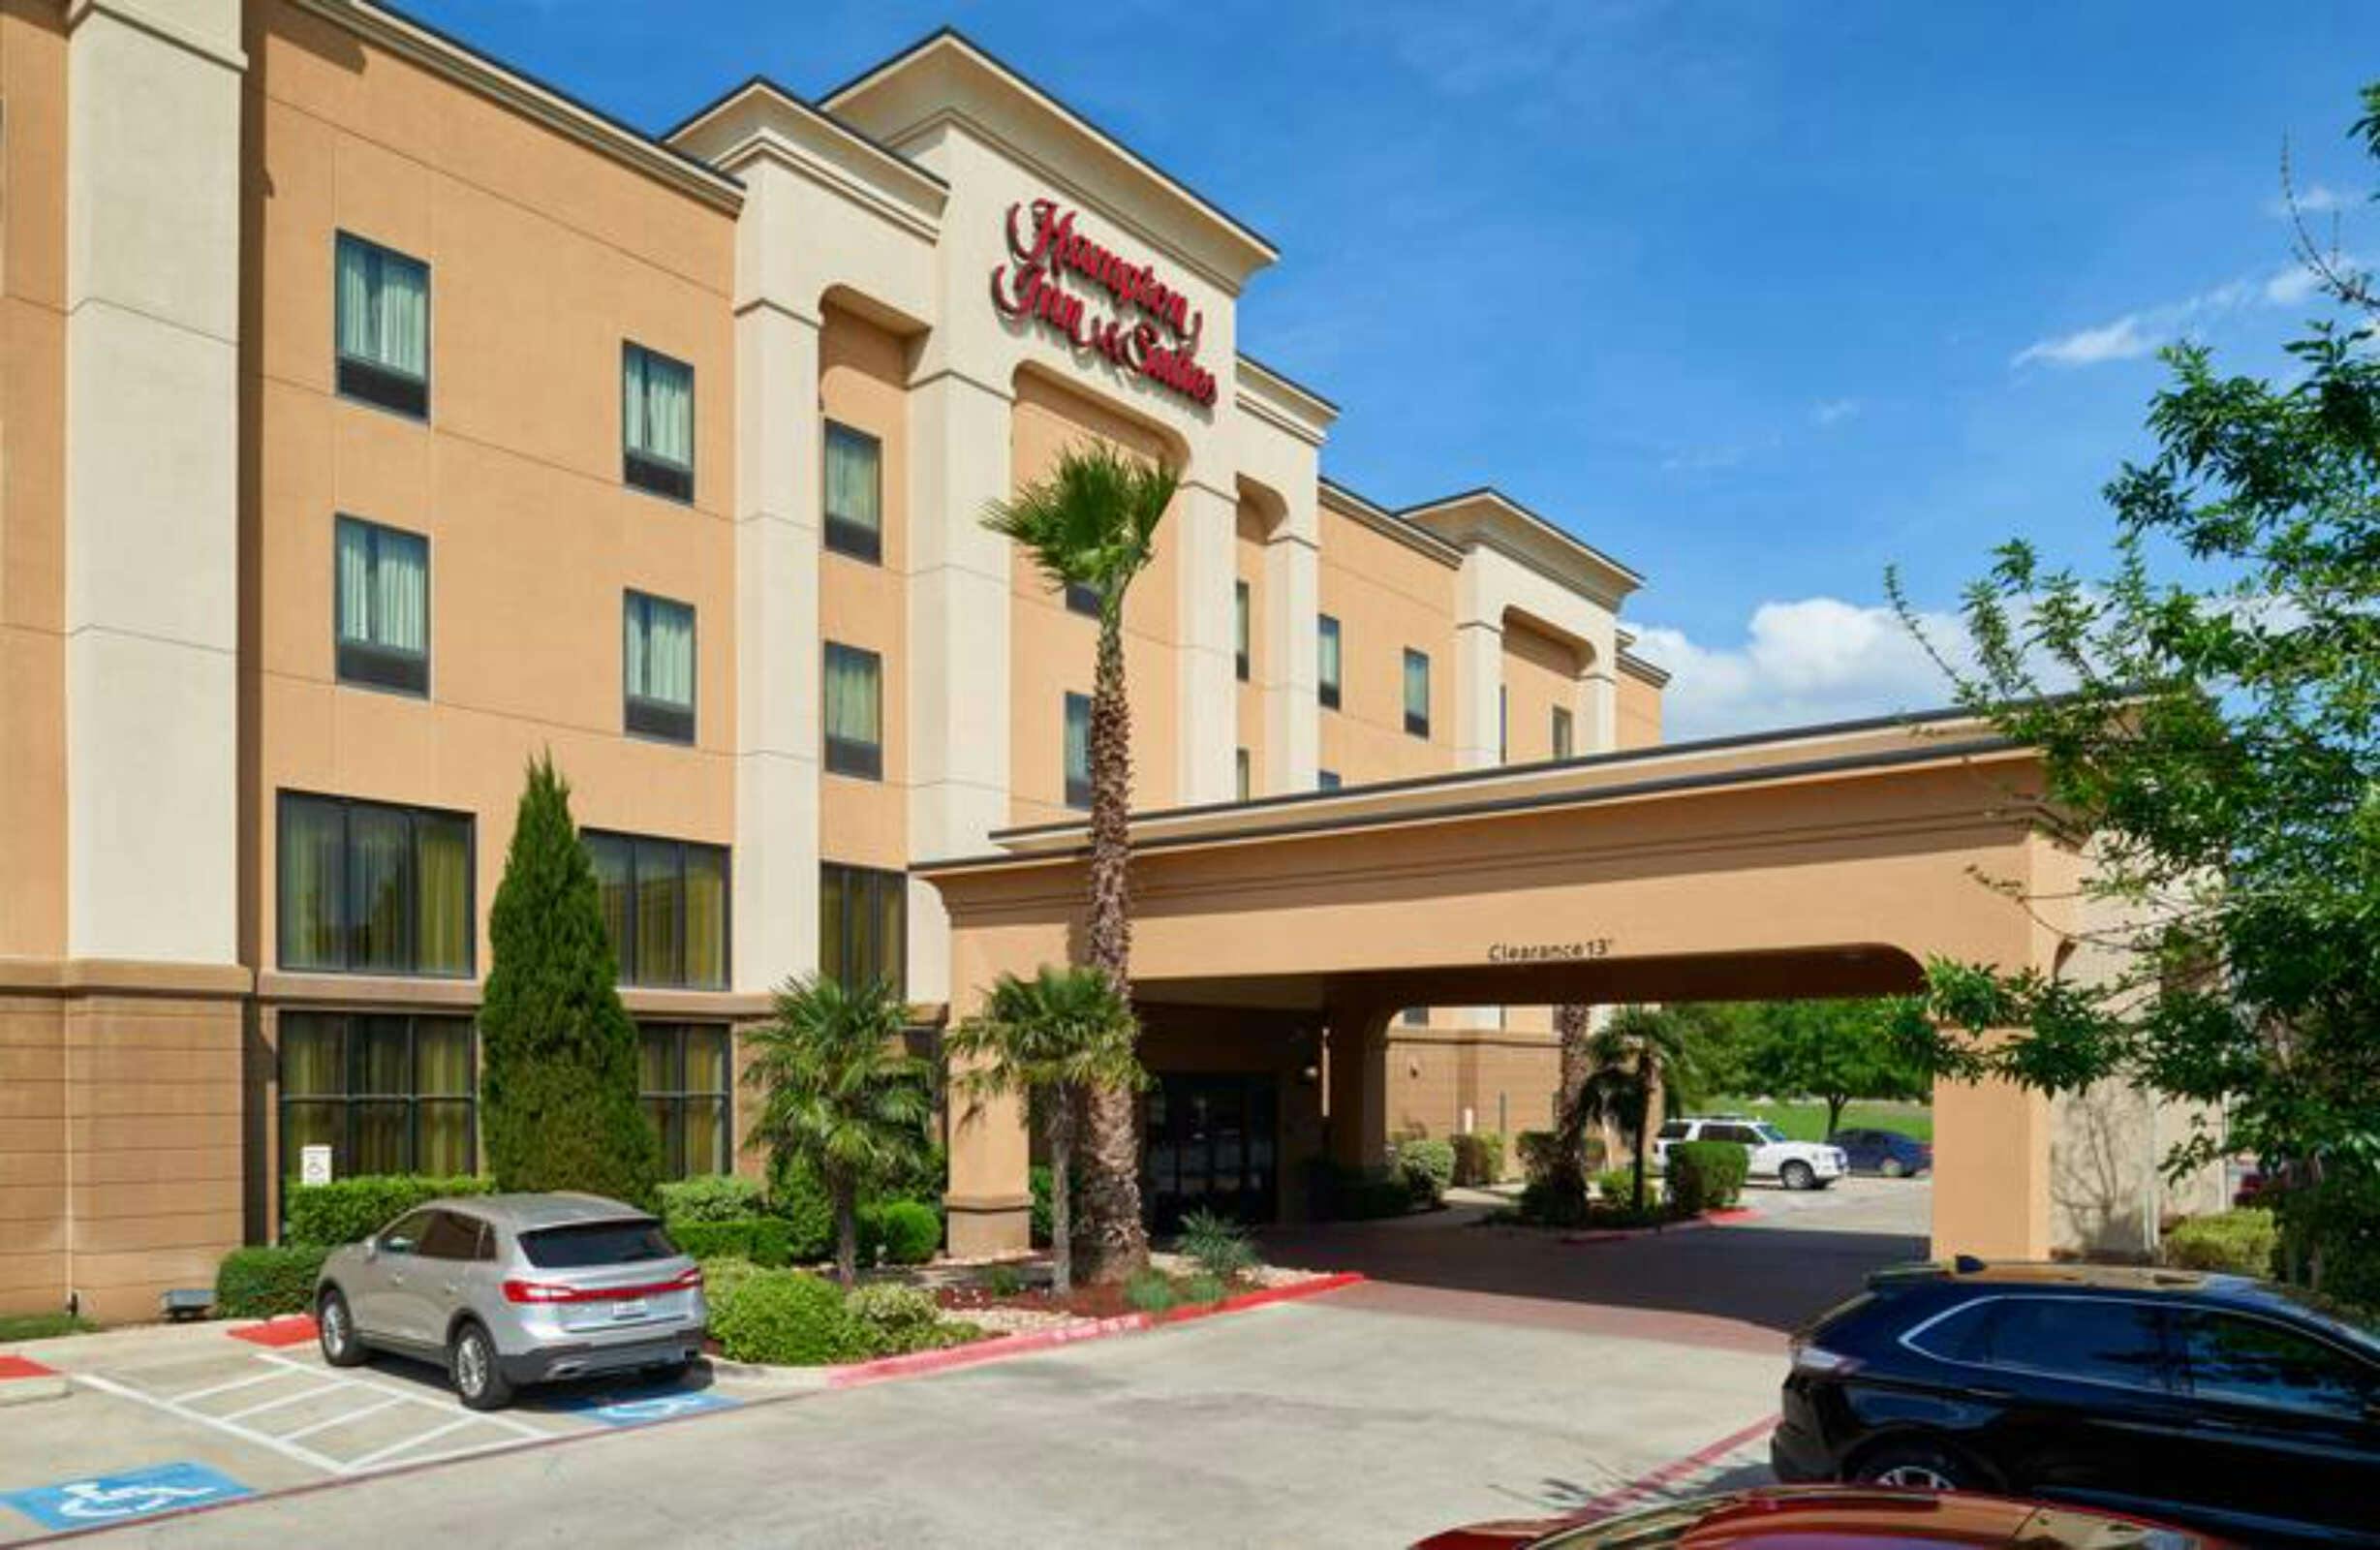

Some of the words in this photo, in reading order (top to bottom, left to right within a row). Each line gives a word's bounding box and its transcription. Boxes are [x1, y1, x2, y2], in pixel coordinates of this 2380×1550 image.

[992, 264, 1092, 346] Inn
[1125, 323, 1217, 406] Suites
[1007, 199, 1202, 342] Hampton
[1488, 943, 1583, 960] Clearance
